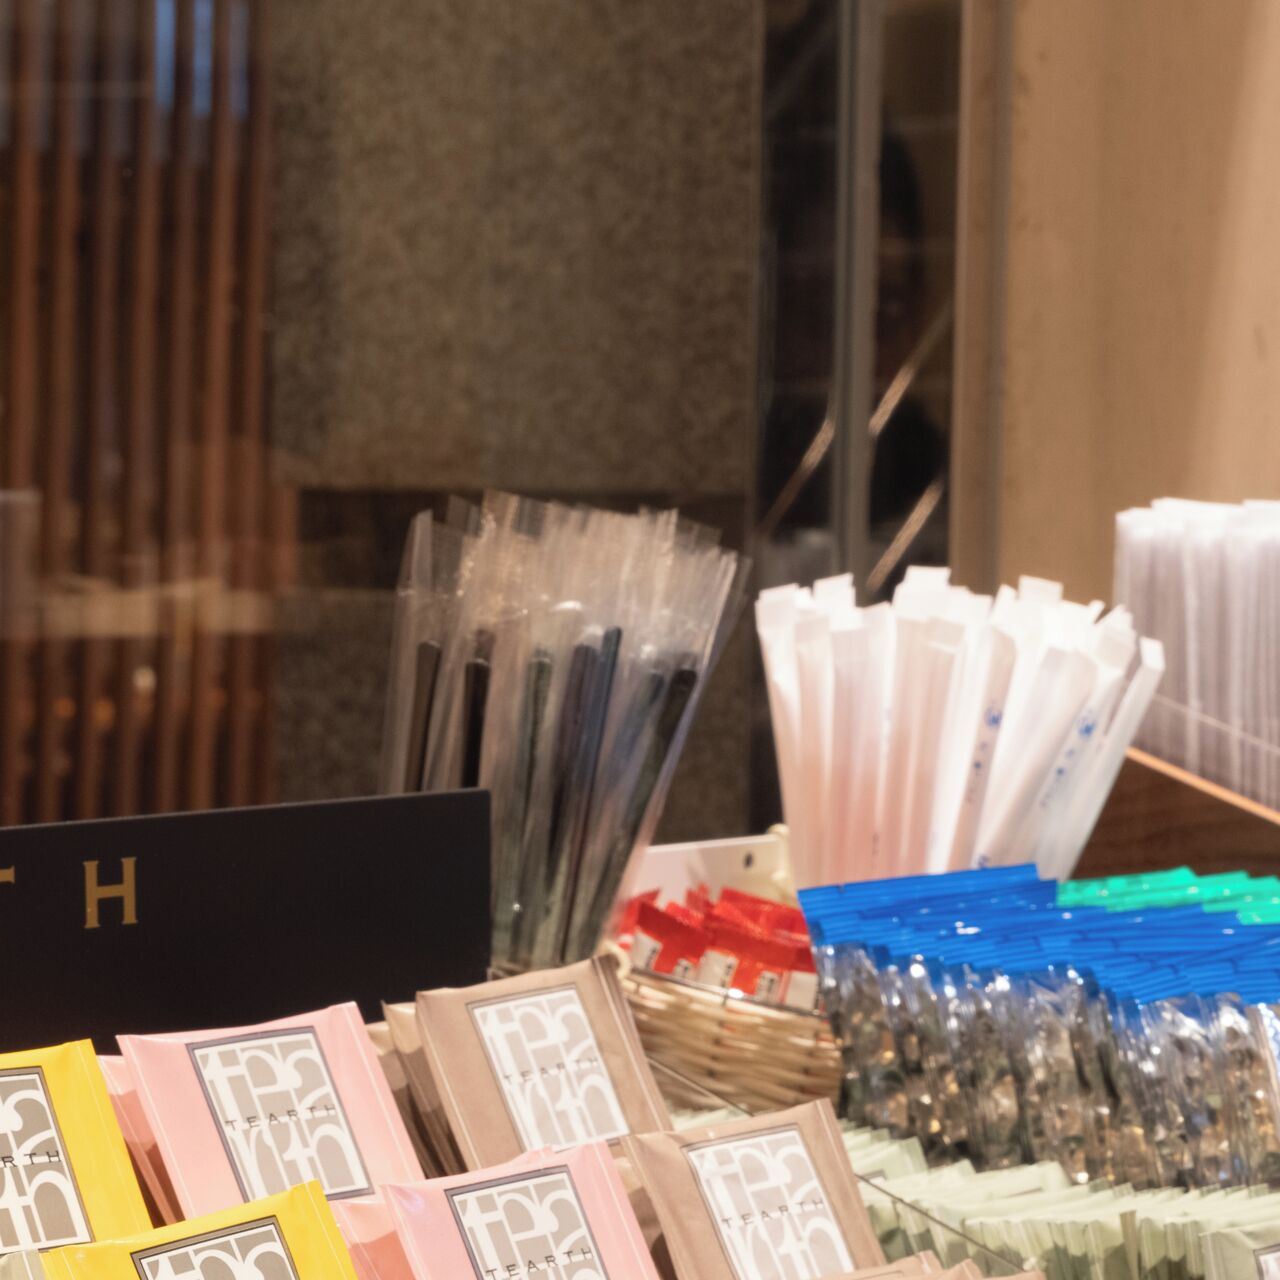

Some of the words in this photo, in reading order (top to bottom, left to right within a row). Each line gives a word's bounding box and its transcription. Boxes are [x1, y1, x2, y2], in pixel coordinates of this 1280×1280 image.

[504, 1056, 599, 1085] TEARTH
[225, 1104, 336, 1130] TEARTH
[722, 1198, 824, 1228] TEARTH
[485, 1247, 594, 1280] TEARTH
